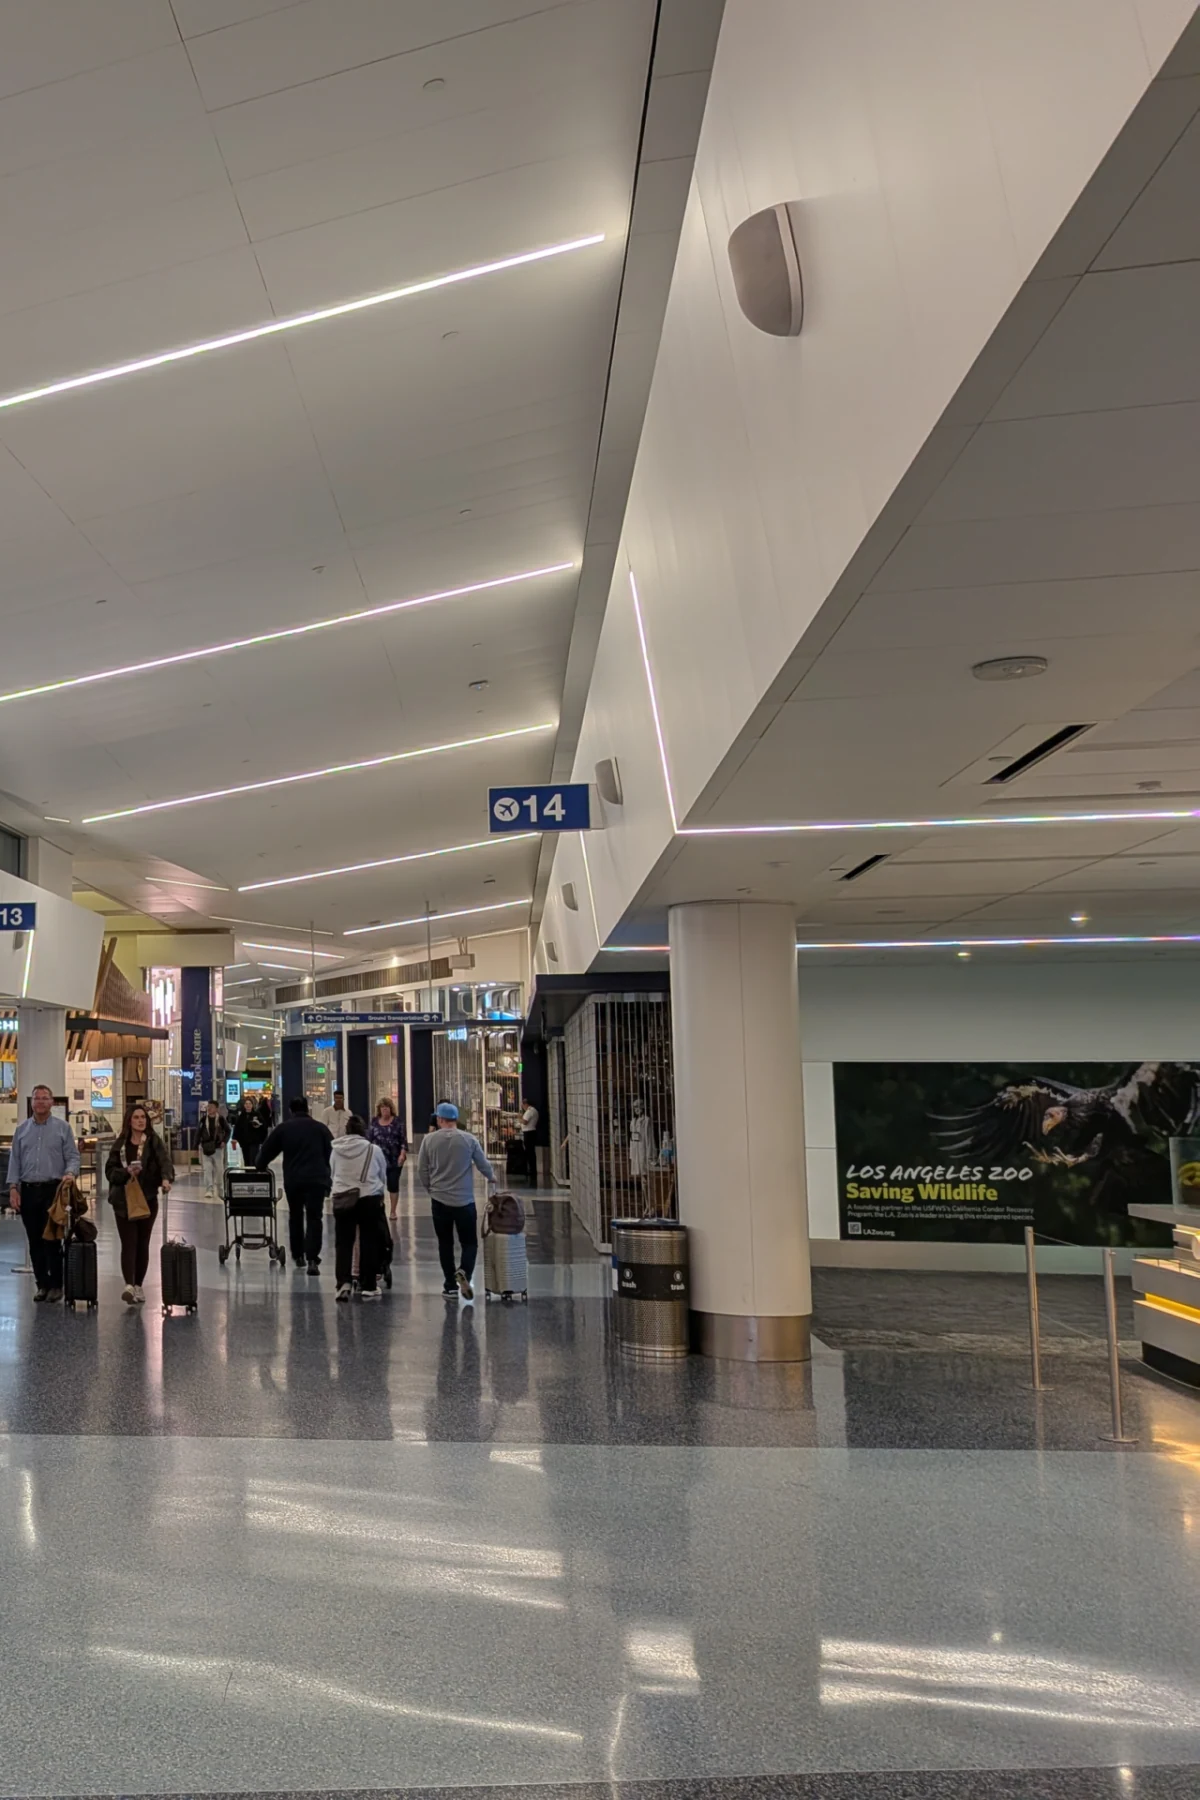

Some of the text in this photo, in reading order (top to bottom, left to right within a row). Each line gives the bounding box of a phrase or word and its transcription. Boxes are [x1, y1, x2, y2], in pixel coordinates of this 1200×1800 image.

[522, 793, 566, 823] 14
[0, 907, 23, 926] 13
[191, 1028, 203, 1096] Brookstone
[846, 1164, 1033, 1183] LOS ANGELES ZOO
[846, 1182, 998, 1203] Saving Wildlife
[975, 1213, 1011, 1221] endangered
[1006, 1206, 1034, 1214] Recovery
[863, 1228, 896, 1237] LAZoo.org
